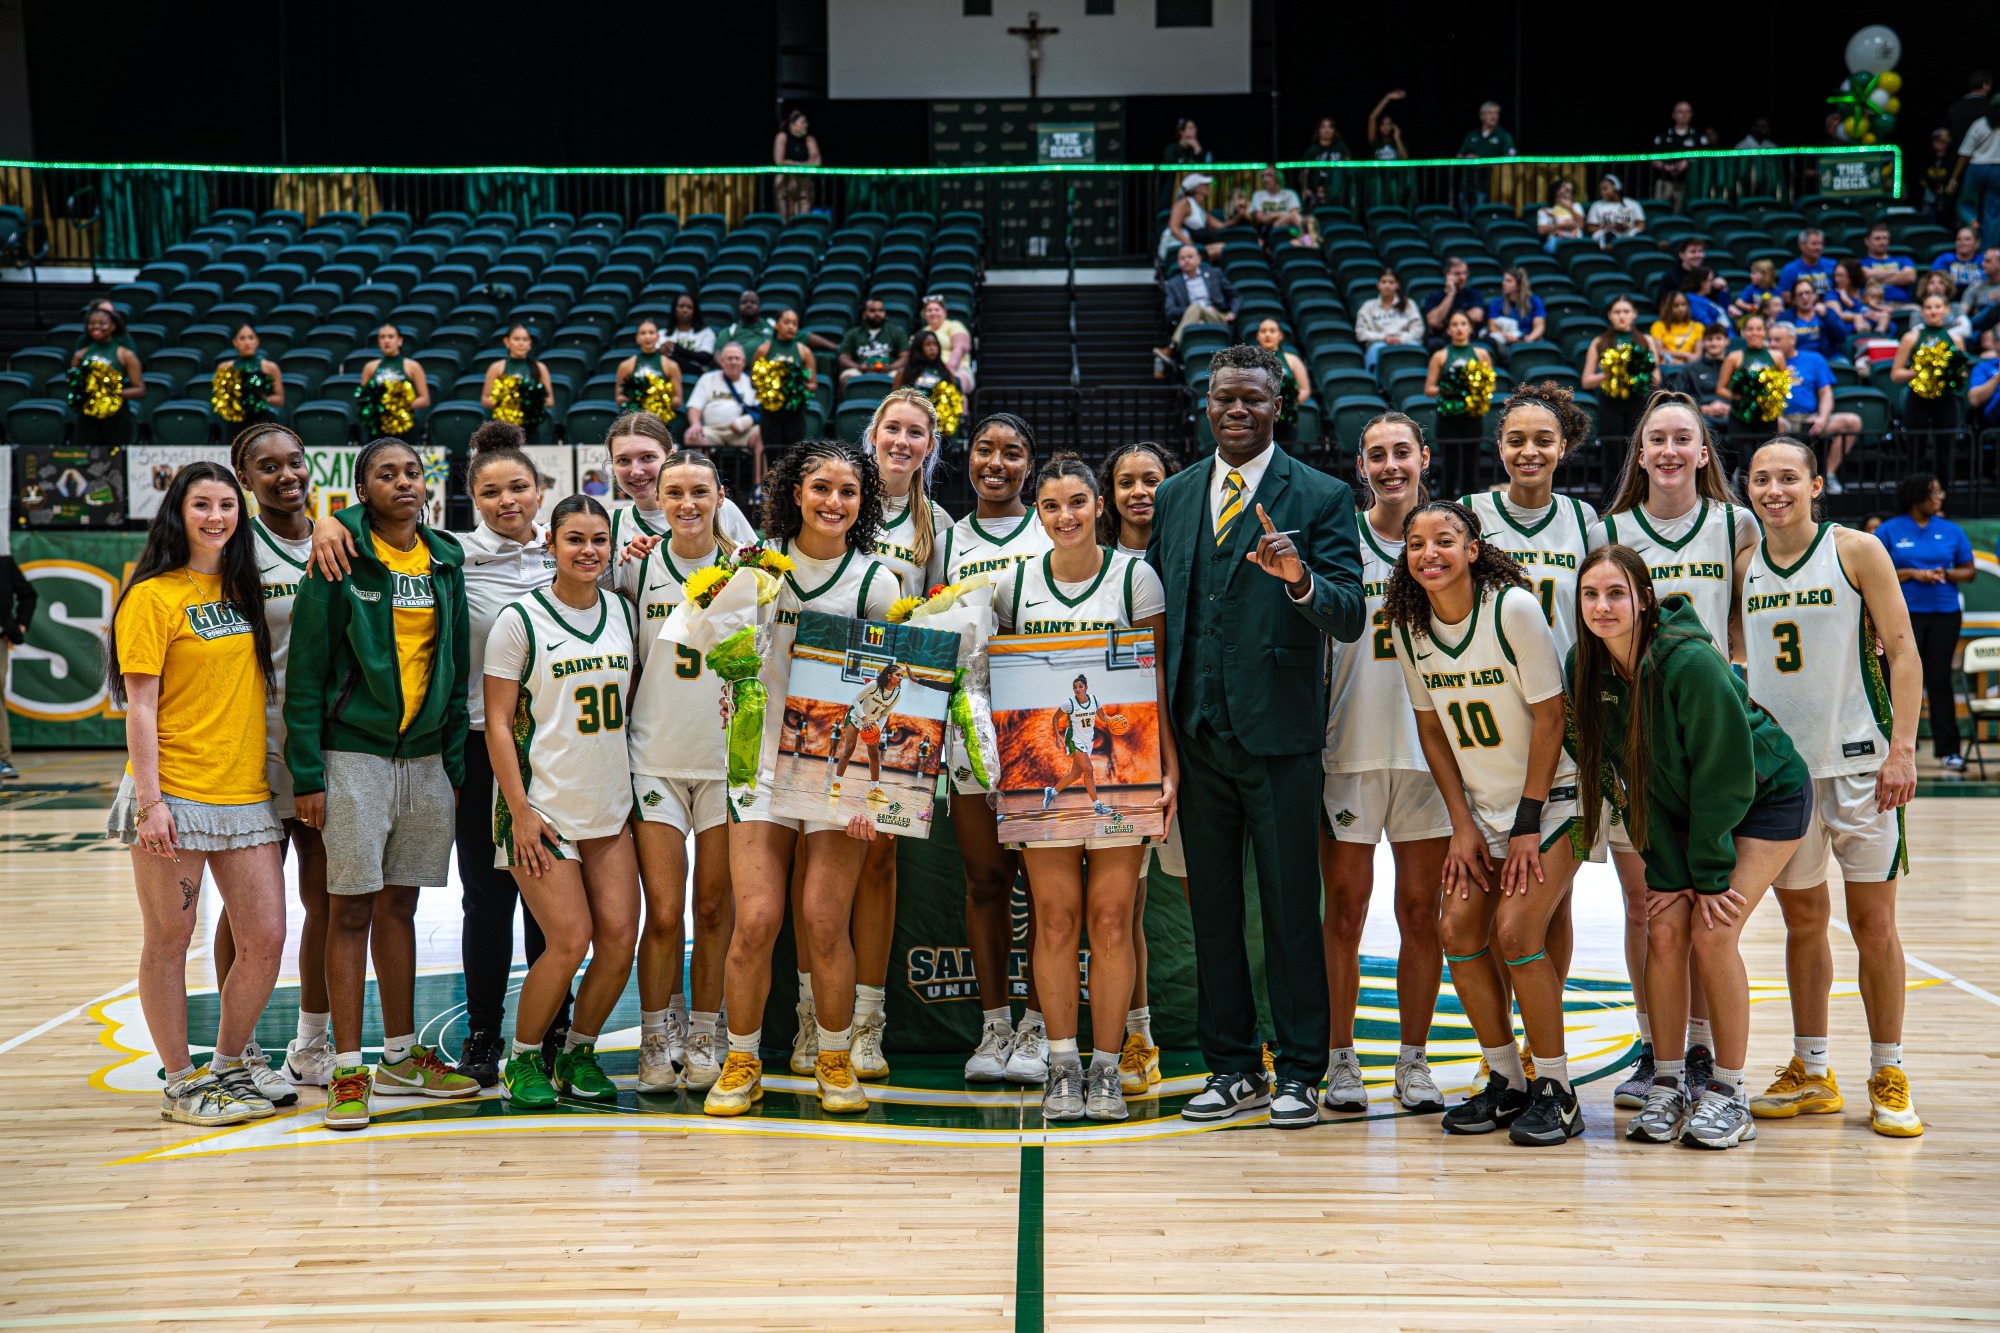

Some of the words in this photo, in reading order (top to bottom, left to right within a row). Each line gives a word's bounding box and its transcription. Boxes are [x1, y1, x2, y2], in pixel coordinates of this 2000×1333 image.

[1052, 132, 1079, 145] THE
[1050, 145, 1083, 158] DECK
[1836, 162, 1866, 175] THE
[1833, 175, 1870, 190] DECK
[958, 556, 1010, 582] SAINT
[1542, 551, 1577, 571] LEO
[1688, 562, 1727, 581] LEO
[1747, 592, 1792, 614] SAINT
[1795, 586, 1834, 606] LEO
[206, 626, 232, 638] WOMEN'S
[1023, 620, 1075, 635] SAINT
[1080, 620, 1117, 632] LEO
[1772, 621, 1804, 675] 3
[551, 655, 603, 680] SAINT
[604, 653, 629, 672] LEO
[1469, 667, 1506, 687] LEO
[574, 682, 624, 736] 30
[1446, 700, 1503, 750] 10
